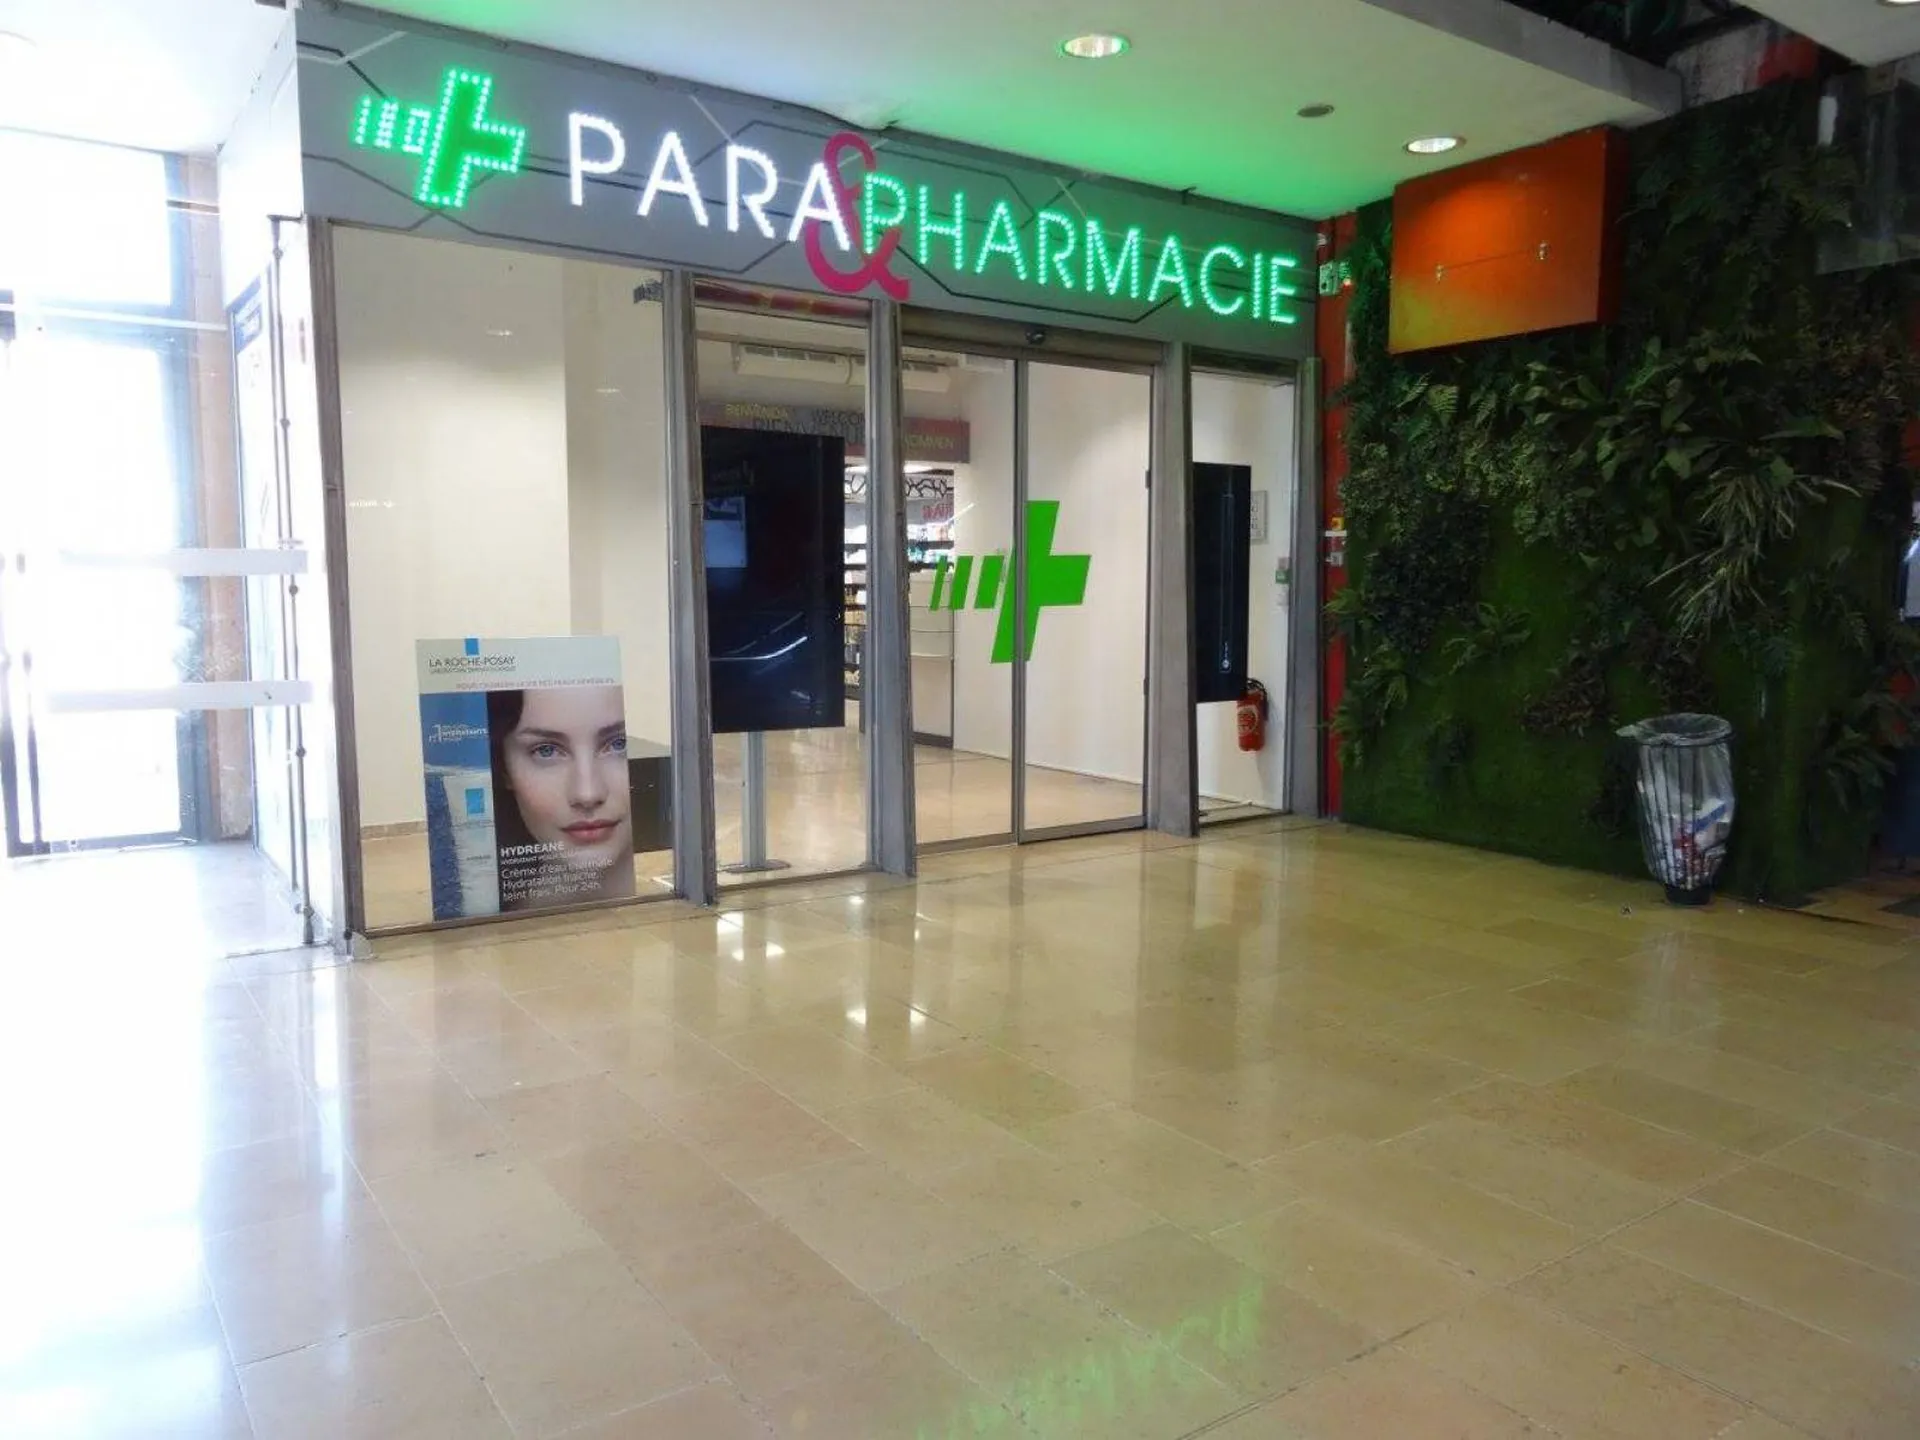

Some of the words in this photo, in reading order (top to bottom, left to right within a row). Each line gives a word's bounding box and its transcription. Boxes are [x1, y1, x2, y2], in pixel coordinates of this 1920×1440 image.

[568, 111, 851, 252] PARA
[864, 171, 1298, 325] PHARMACIE
[429, 658, 442, 668] LA
[444, 655, 516, 667] ROCHE-POSAY
[500, 841, 565, 857] HYDREANE
